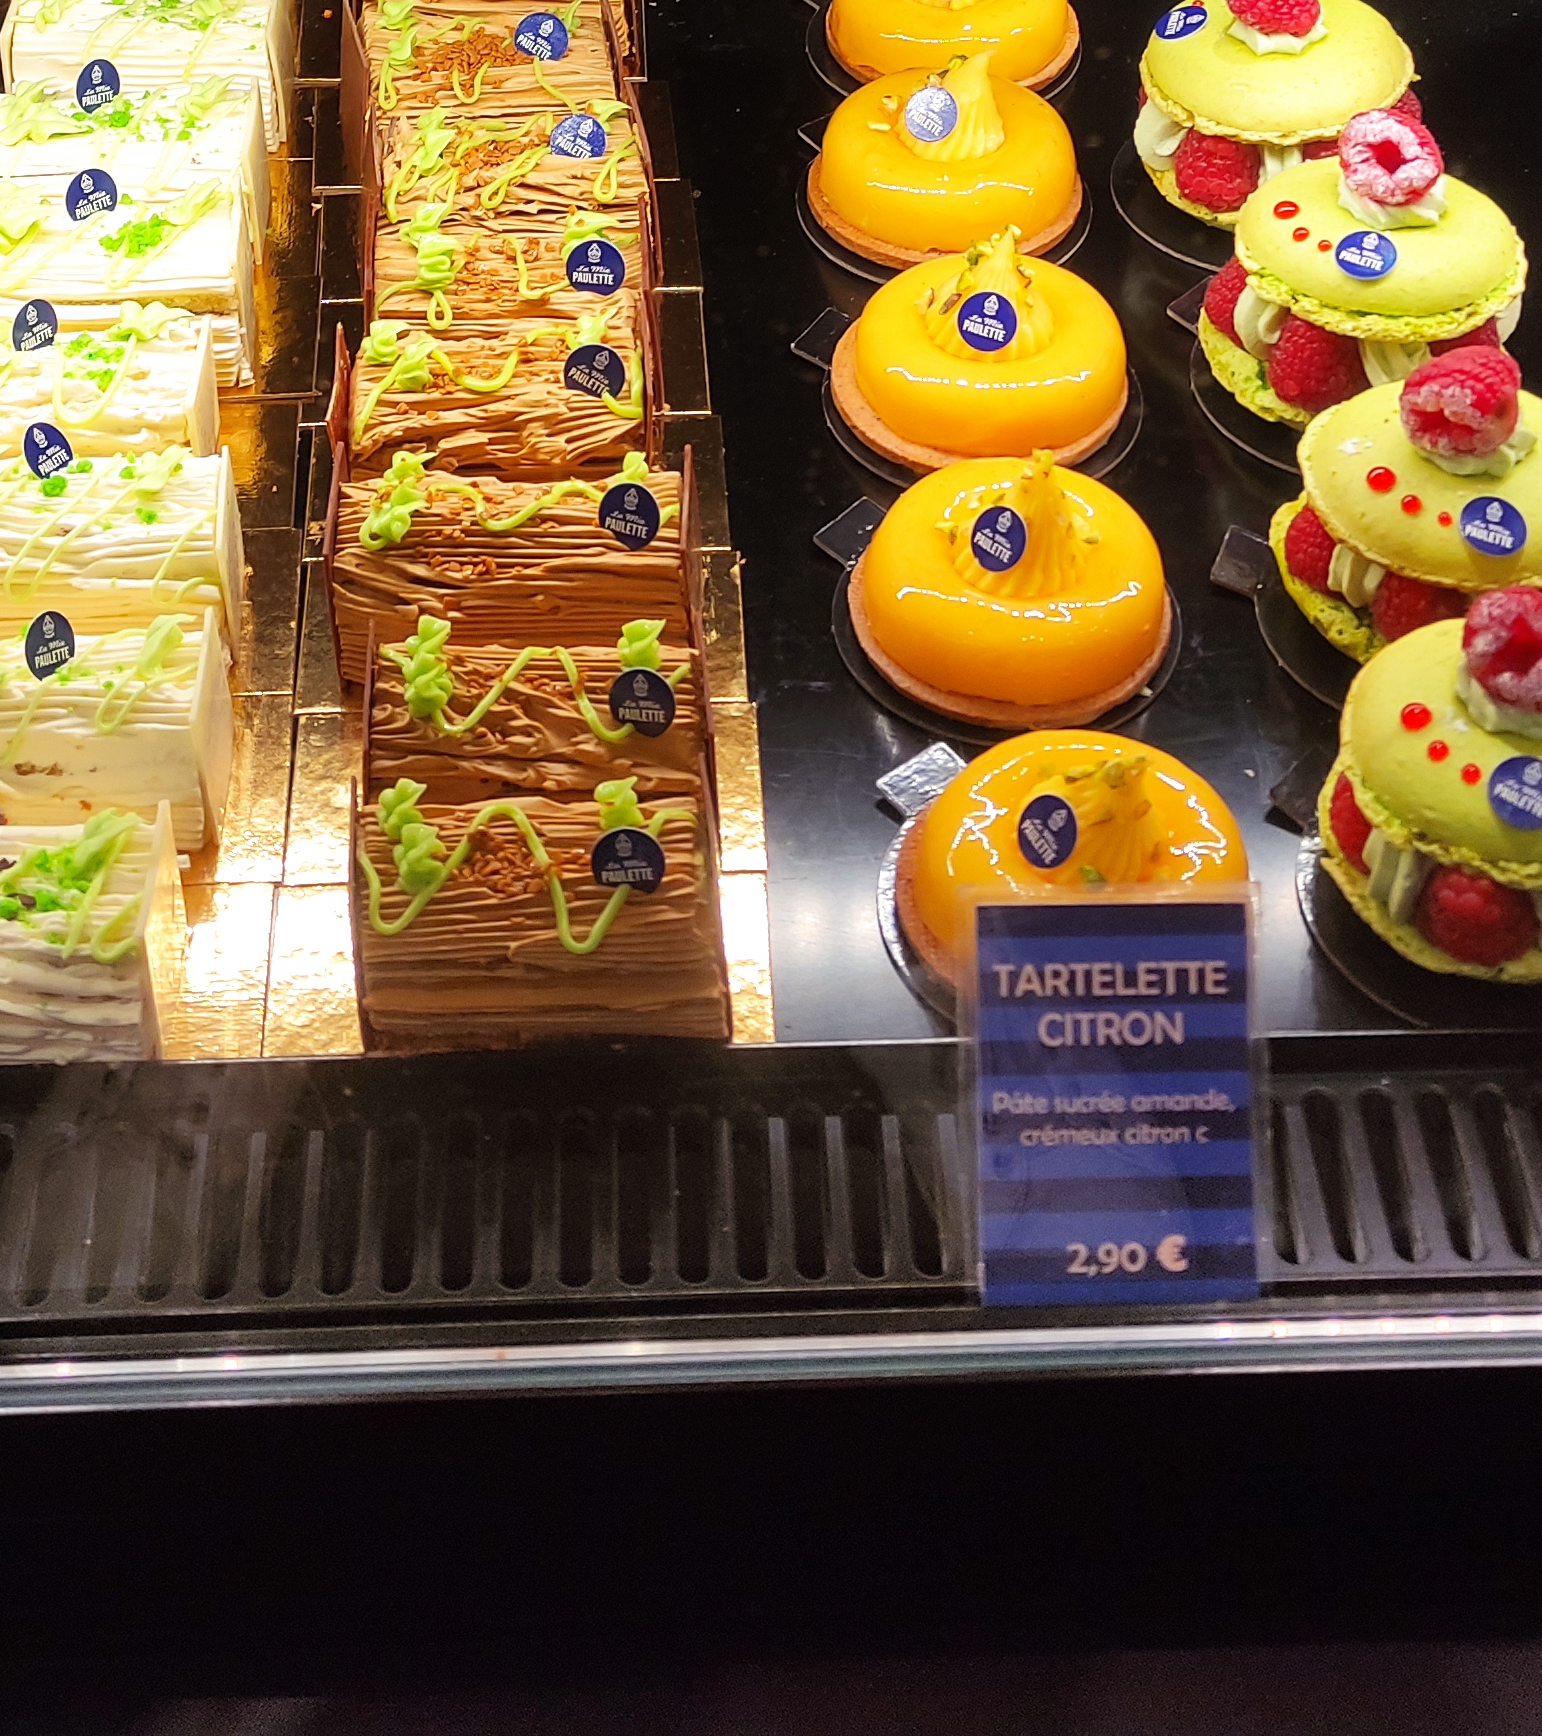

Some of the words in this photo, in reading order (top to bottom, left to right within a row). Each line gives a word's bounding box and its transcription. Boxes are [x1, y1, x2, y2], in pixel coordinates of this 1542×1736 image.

[516, 34, 552, 60] PAULETTE
[82, 91, 114, 107] PAULETTE
[75, 196, 113, 220] PAULETTE
[79, 197, 91, 206] La
[93, 191, 106, 201] Mie
[572, 272, 614, 285] PAULETTE
[591, 265, 611, 273] Mie
[19, 329, 53, 352] PAULETTE
[962, 320, 1006, 342] PAULETTE
[577, 365, 591, 374] La
[592, 370, 608, 384] Mie
[38, 453, 69, 476] PAULETTE
[605, 517, 648, 539] PAULETTE
[35, 648, 70, 669] PAULETTE
[993, 960, 1229, 998] TARTELETTE
[1037, 1011, 1186, 1047] CITRON
[992, 1090, 1049, 1115] Pâte
[1054, 1089, 1125, 1114] sucrée
[1130, 1088, 1237, 1113] amande,
[1020, 1124, 1119, 1147] crémeux
[1125, 1125, 1191, 1144] citron
[1065, 1241, 1149, 1277] 2,90
[1156, 1233, 1190, 1273] €
